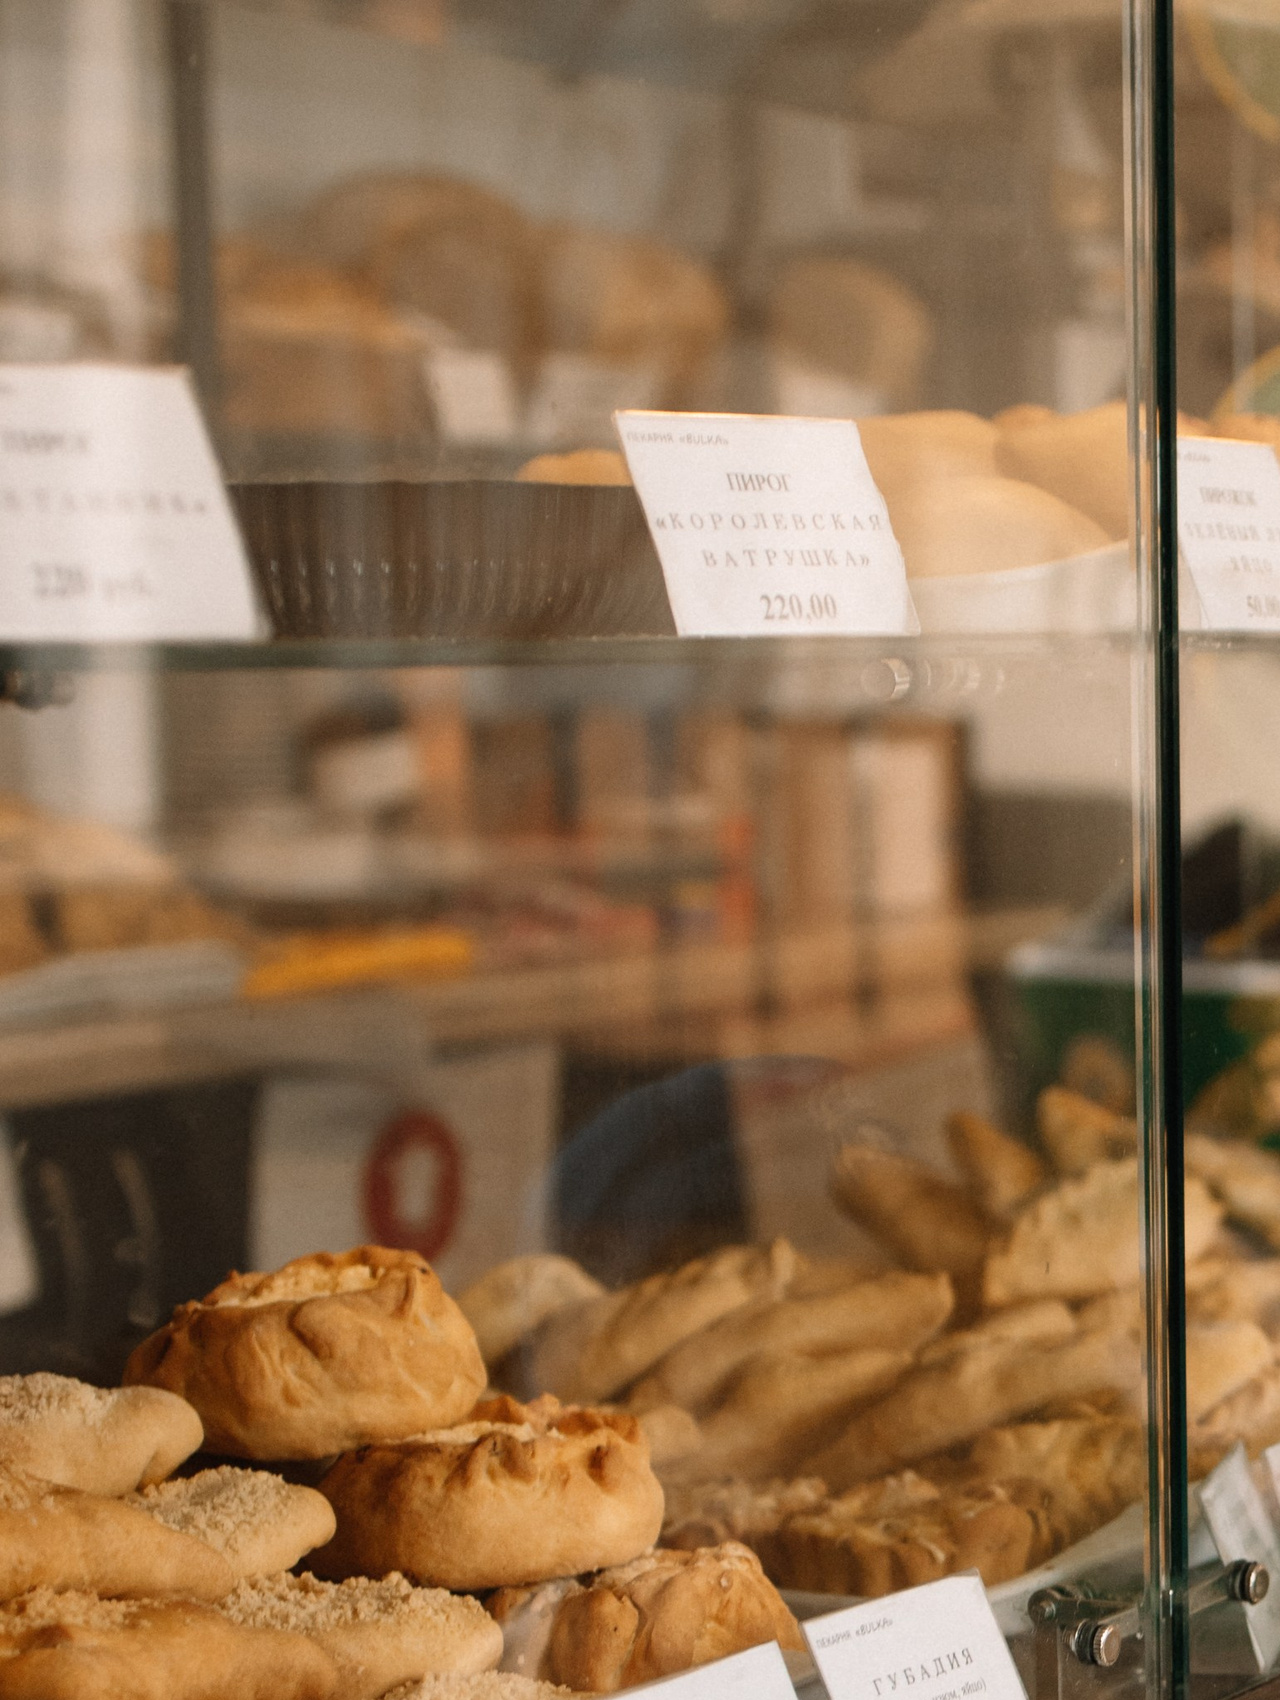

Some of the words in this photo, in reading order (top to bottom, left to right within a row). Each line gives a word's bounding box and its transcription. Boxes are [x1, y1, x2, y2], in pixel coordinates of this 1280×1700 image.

[726, 472, 791, 492] ПИРОГ
[656, 513, 884, 531] «КОРОЛЕВСКАЯ
[703, 549, 870, 568] ВАТРУШКА»
[760, 594, 838, 623] 220,00
[873, 1648, 974, 1696] ГУБАДИЯ
